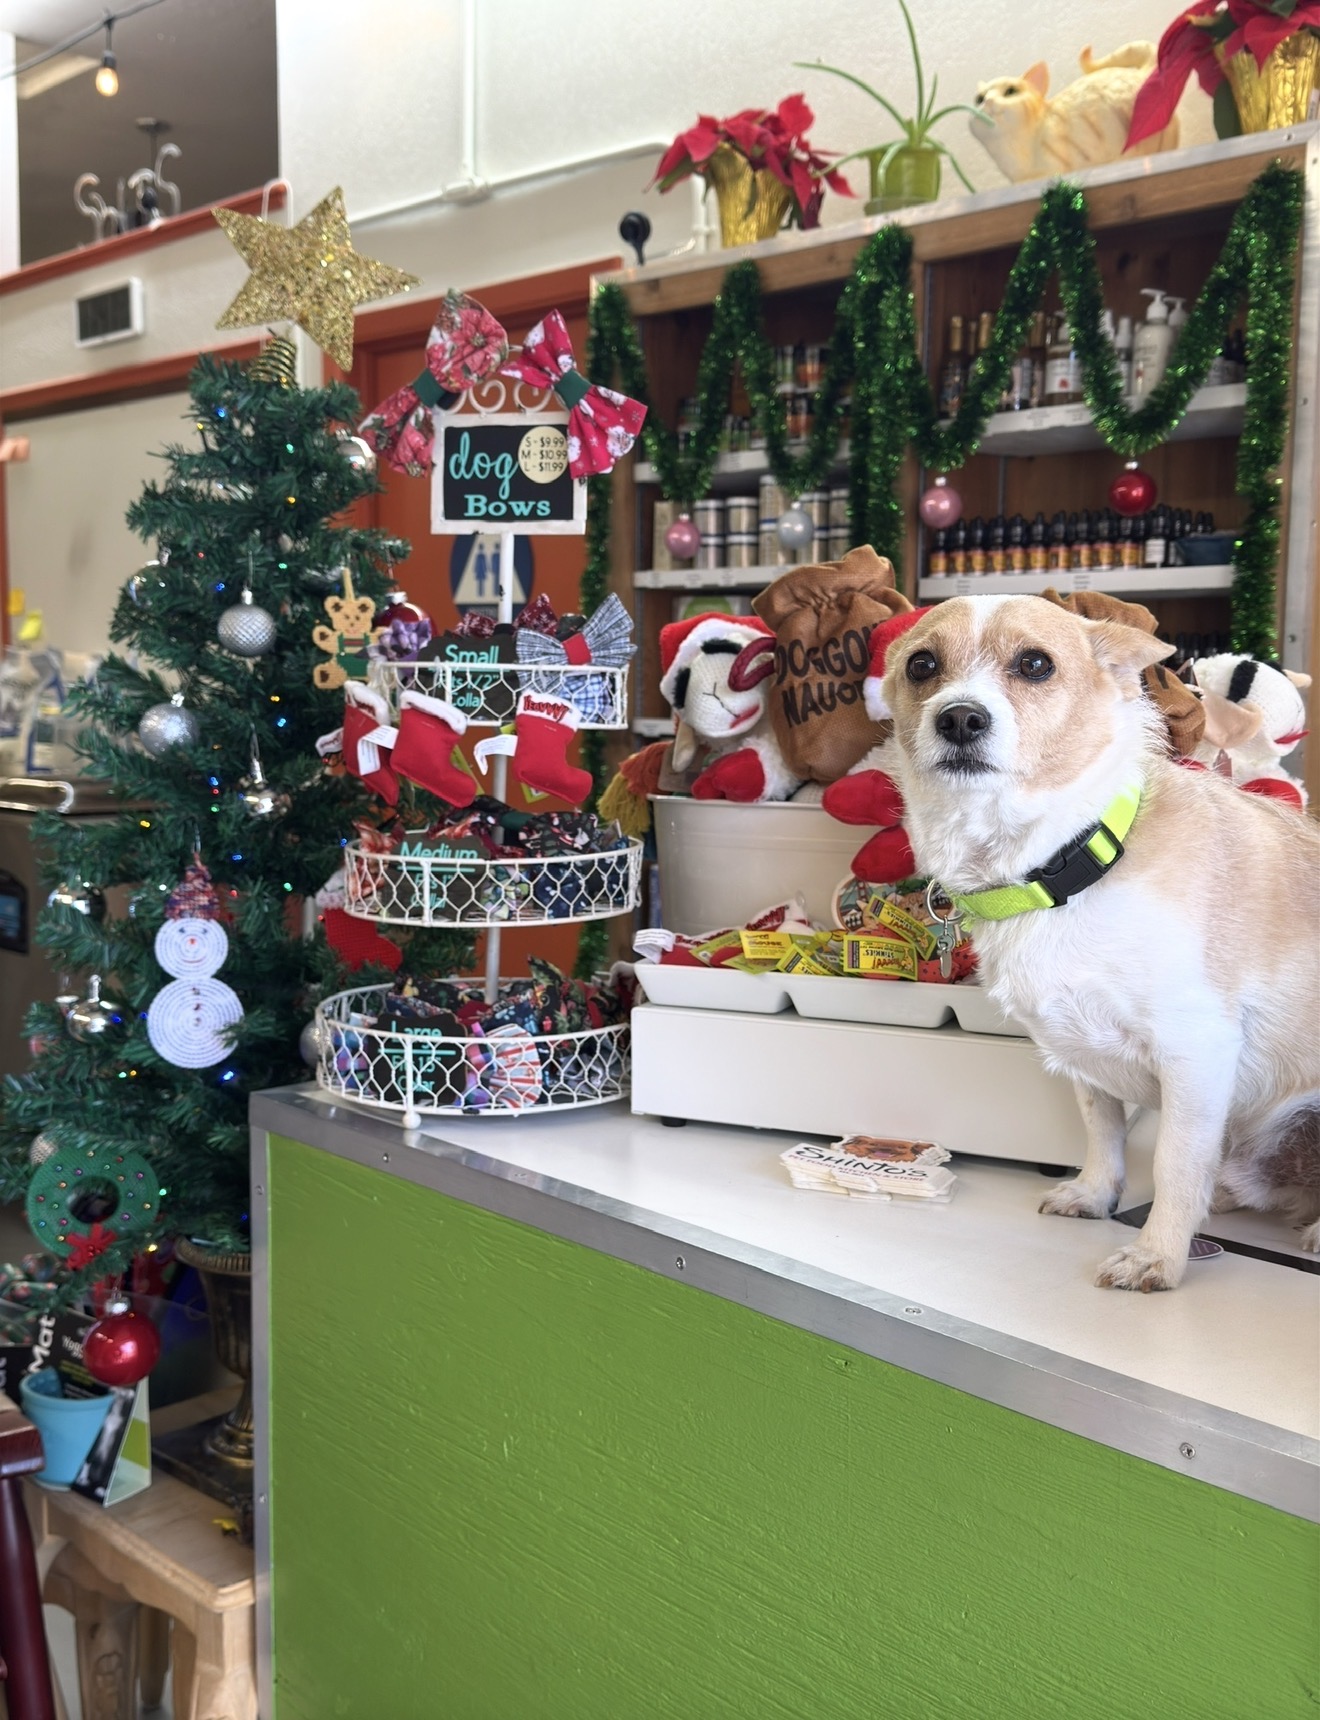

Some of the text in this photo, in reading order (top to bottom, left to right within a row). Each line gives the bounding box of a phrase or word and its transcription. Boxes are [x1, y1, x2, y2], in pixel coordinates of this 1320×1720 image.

[525, 436, 532, 448] S
[540, 436, 565, 448] $9.99
[521, 450, 531, 460] M
[539, 450, 568, 460] $10.99
[449, 431, 519, 500] dog
[524, 461, 531, 472] L
[539, 461, 564, 472] $11.99
[463, 494, 551, 517] Bows
[445, 644, 500, 665] Small
[449, 691, 487, 707] olla
[401, 841, 479, 859] Medium
[391, 1020, 442, 1050] Large
